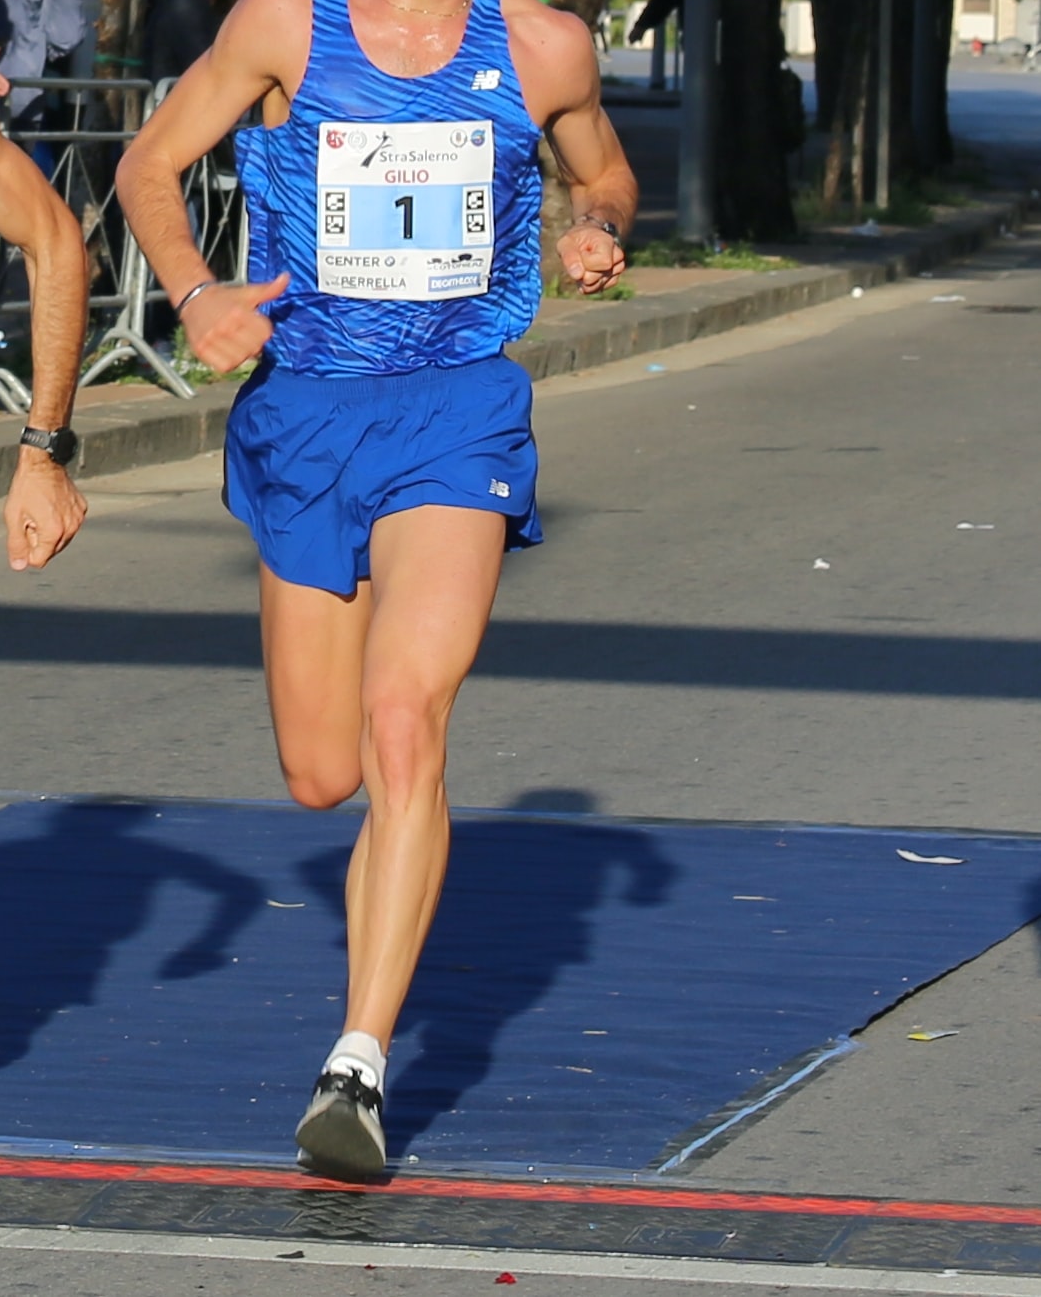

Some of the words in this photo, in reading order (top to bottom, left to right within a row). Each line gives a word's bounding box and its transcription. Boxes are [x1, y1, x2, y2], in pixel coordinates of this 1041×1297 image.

[379, 150, 458, 162] StraSalerno
[384, 169, 430, 183] GILIO
[394, 195, 414, 240] 1
[325, 255, 380, 267] CENTER
[341, 276, 407, 288] PERRELLA
